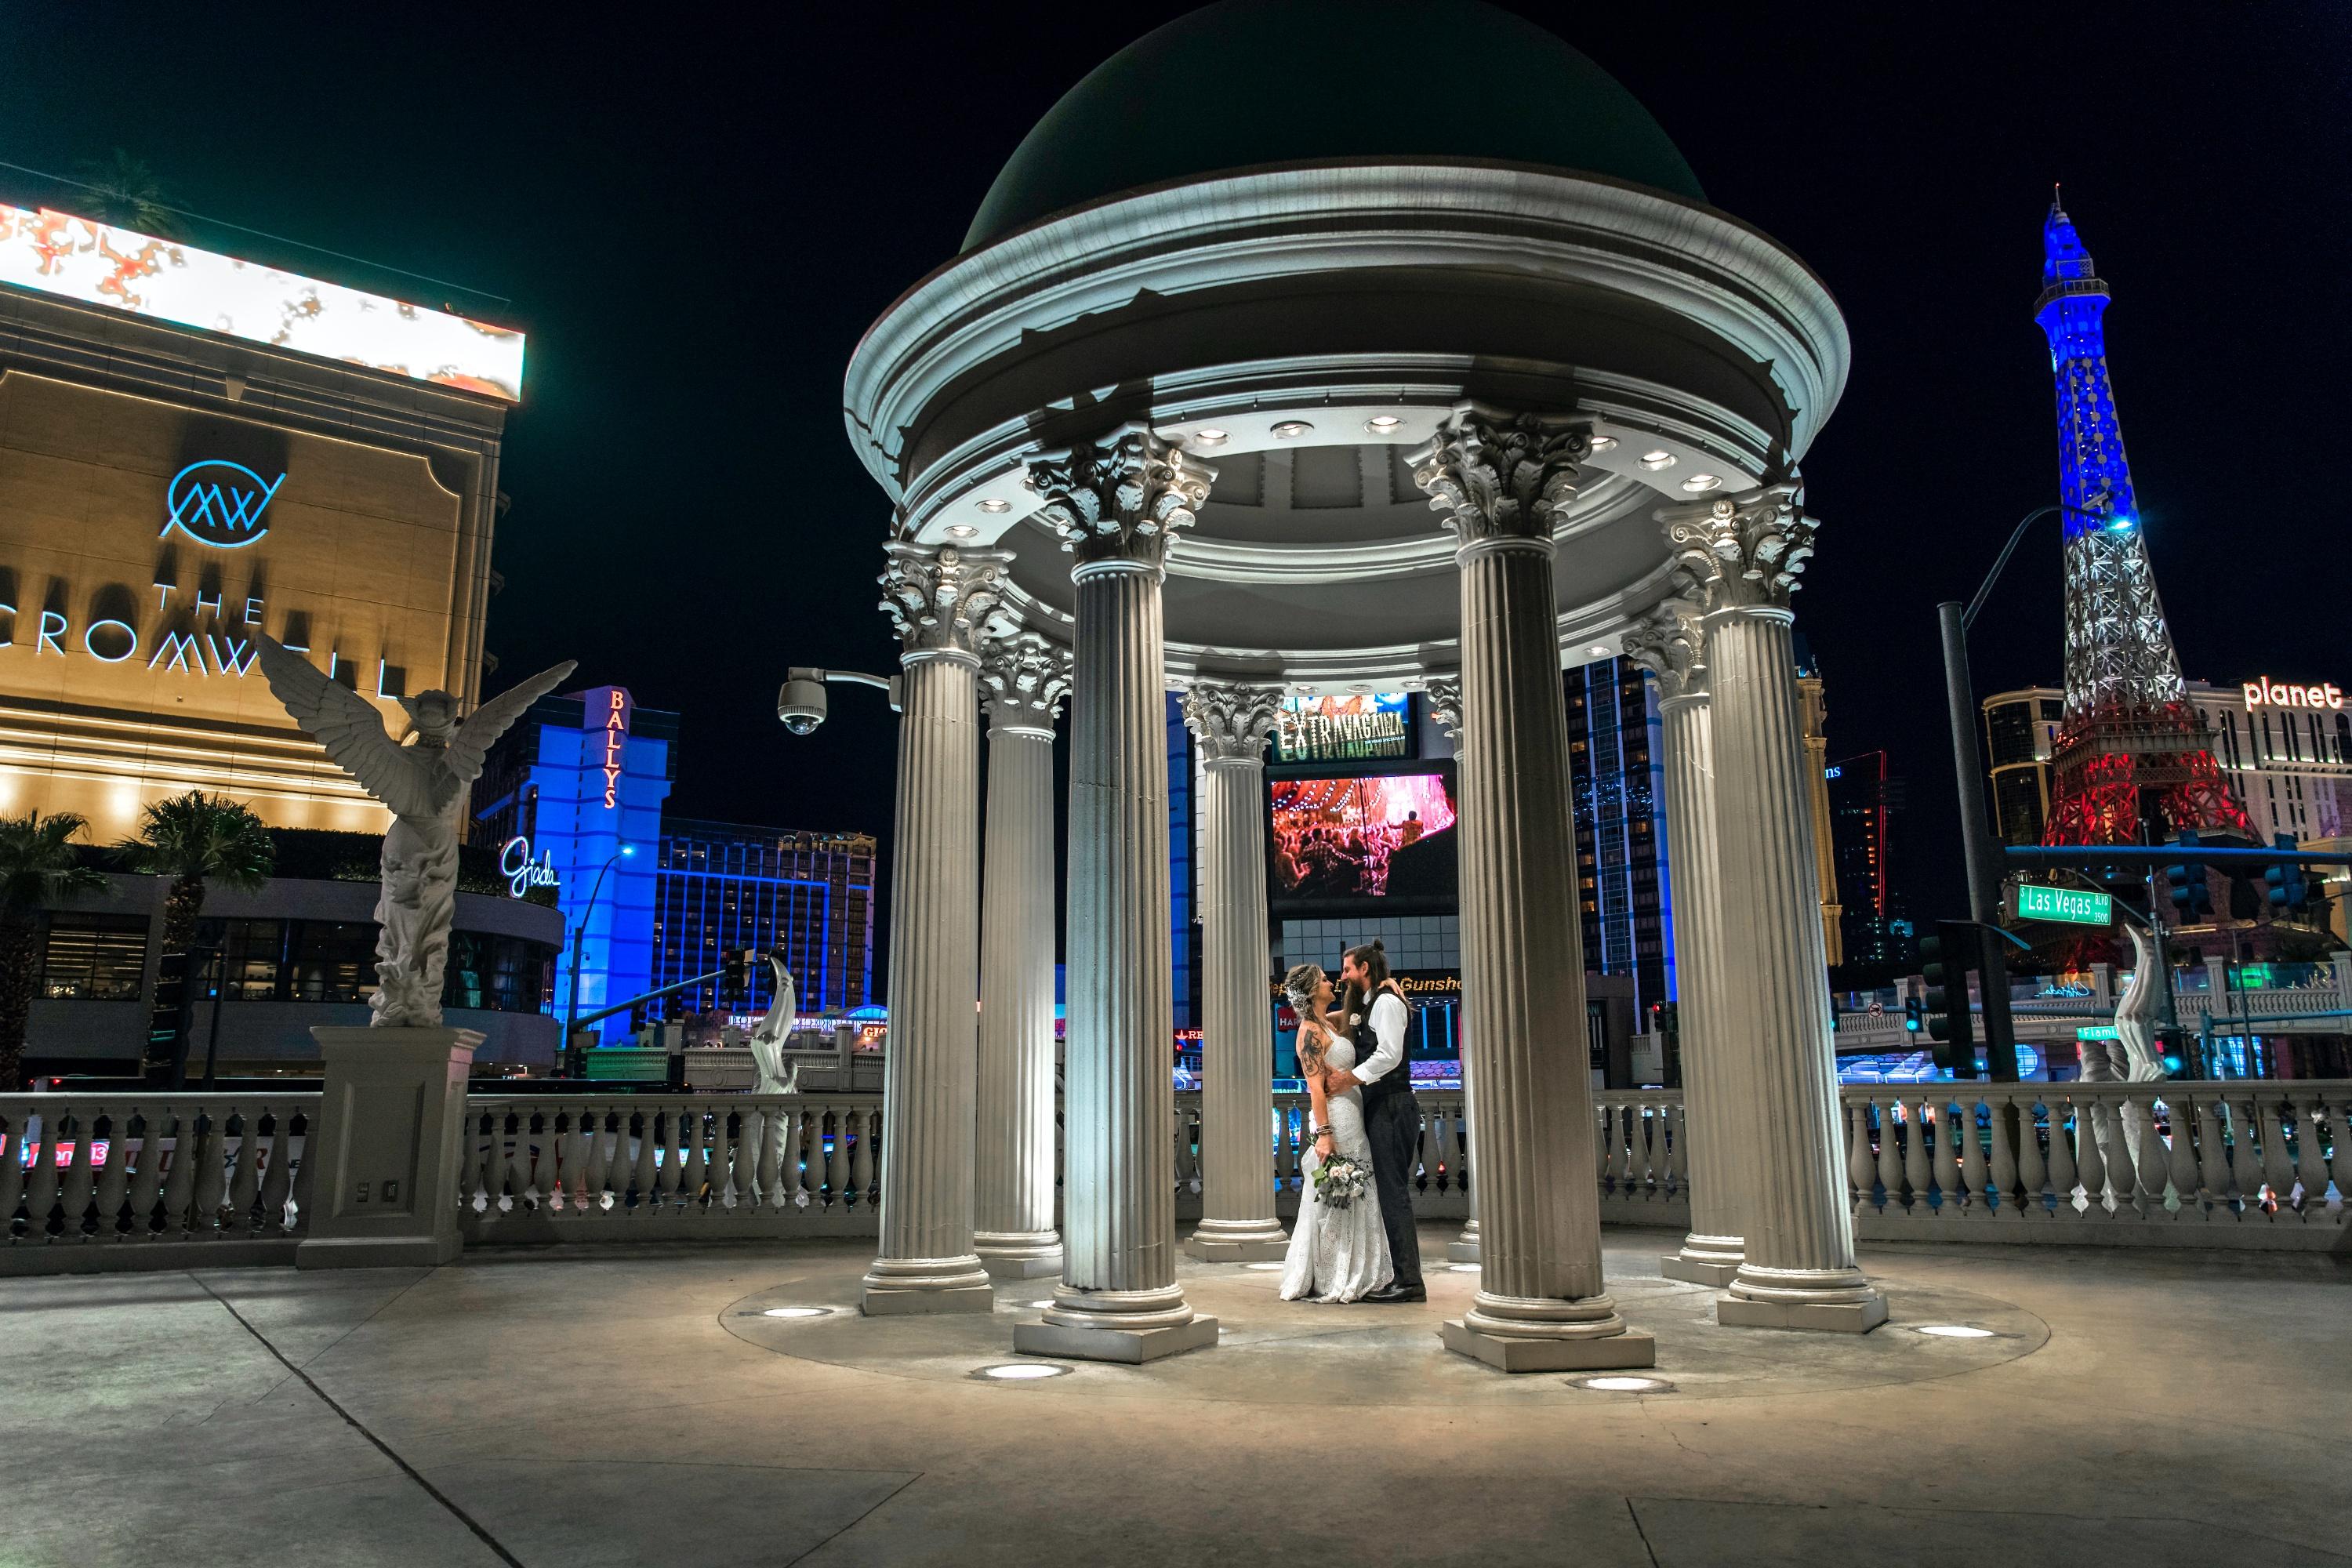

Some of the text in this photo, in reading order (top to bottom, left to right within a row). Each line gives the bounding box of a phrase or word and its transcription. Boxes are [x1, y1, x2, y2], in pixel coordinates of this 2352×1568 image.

[152, 583, 264, 626] THE
[0, 604, 399, 701] ROMWL
[2243, 676, 2343, 712] planet
[603, 690, 624, 809] BALLYS
[2020, 887, 2108, 920] S Las Vegas BLVD
[2094, 912, 2108, 924] 3500
[2084, 1027, 2118, 1038] Flami
